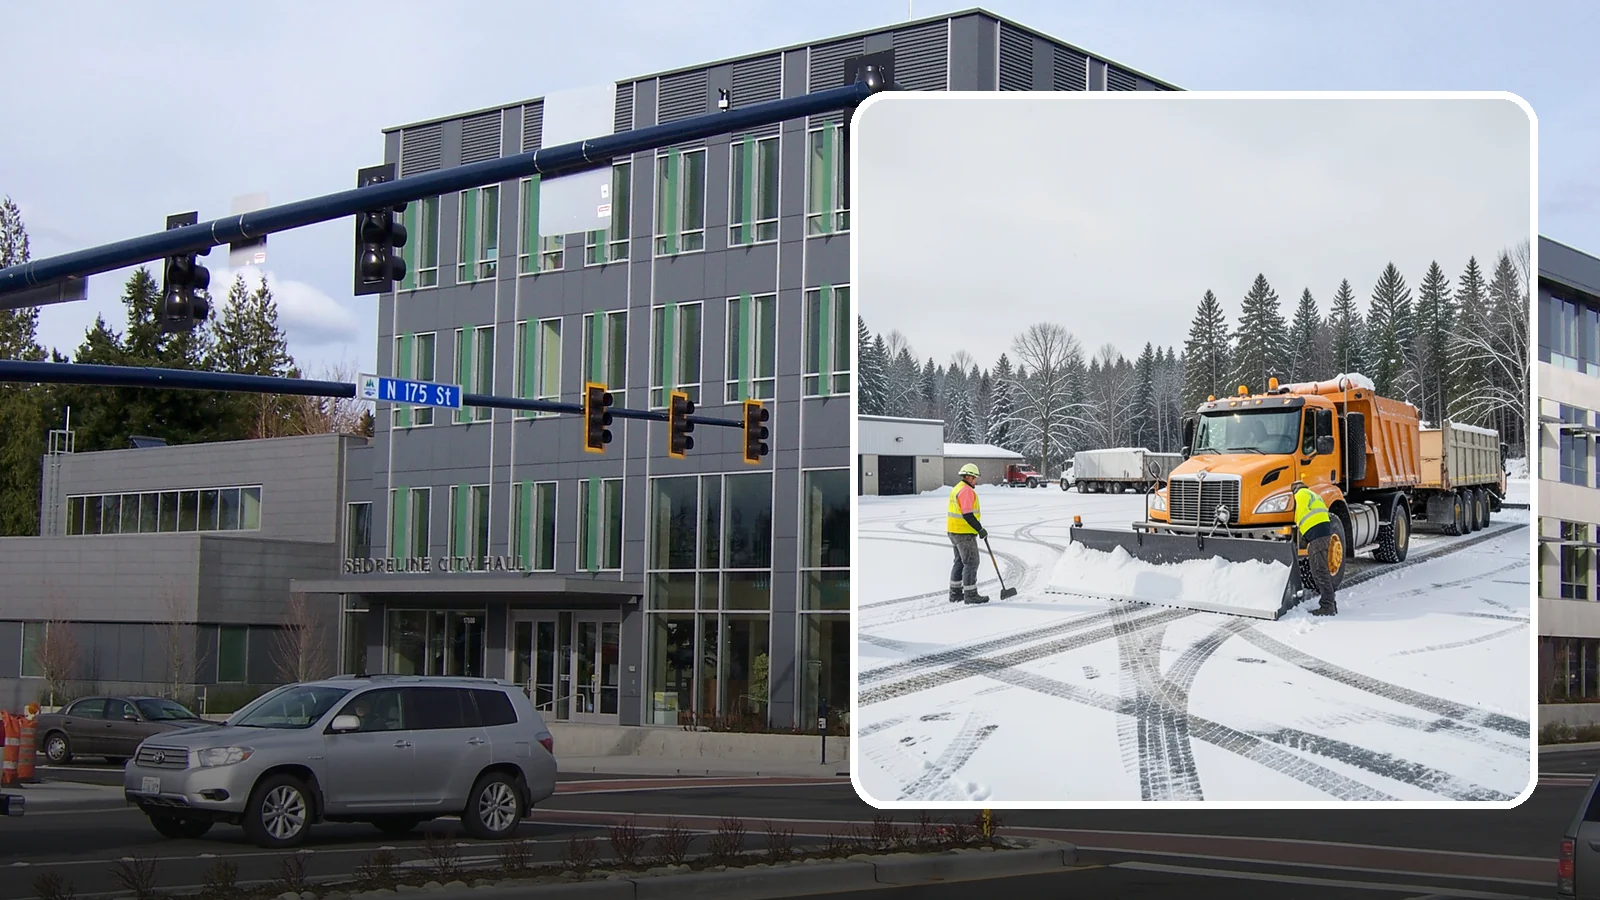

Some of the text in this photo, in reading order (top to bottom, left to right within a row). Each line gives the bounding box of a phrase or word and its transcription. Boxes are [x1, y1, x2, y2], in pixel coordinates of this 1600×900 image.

[387, 380, 451, 406] N 175 St
[344, 555, 525, 574] SHORELINE CITY HALL
